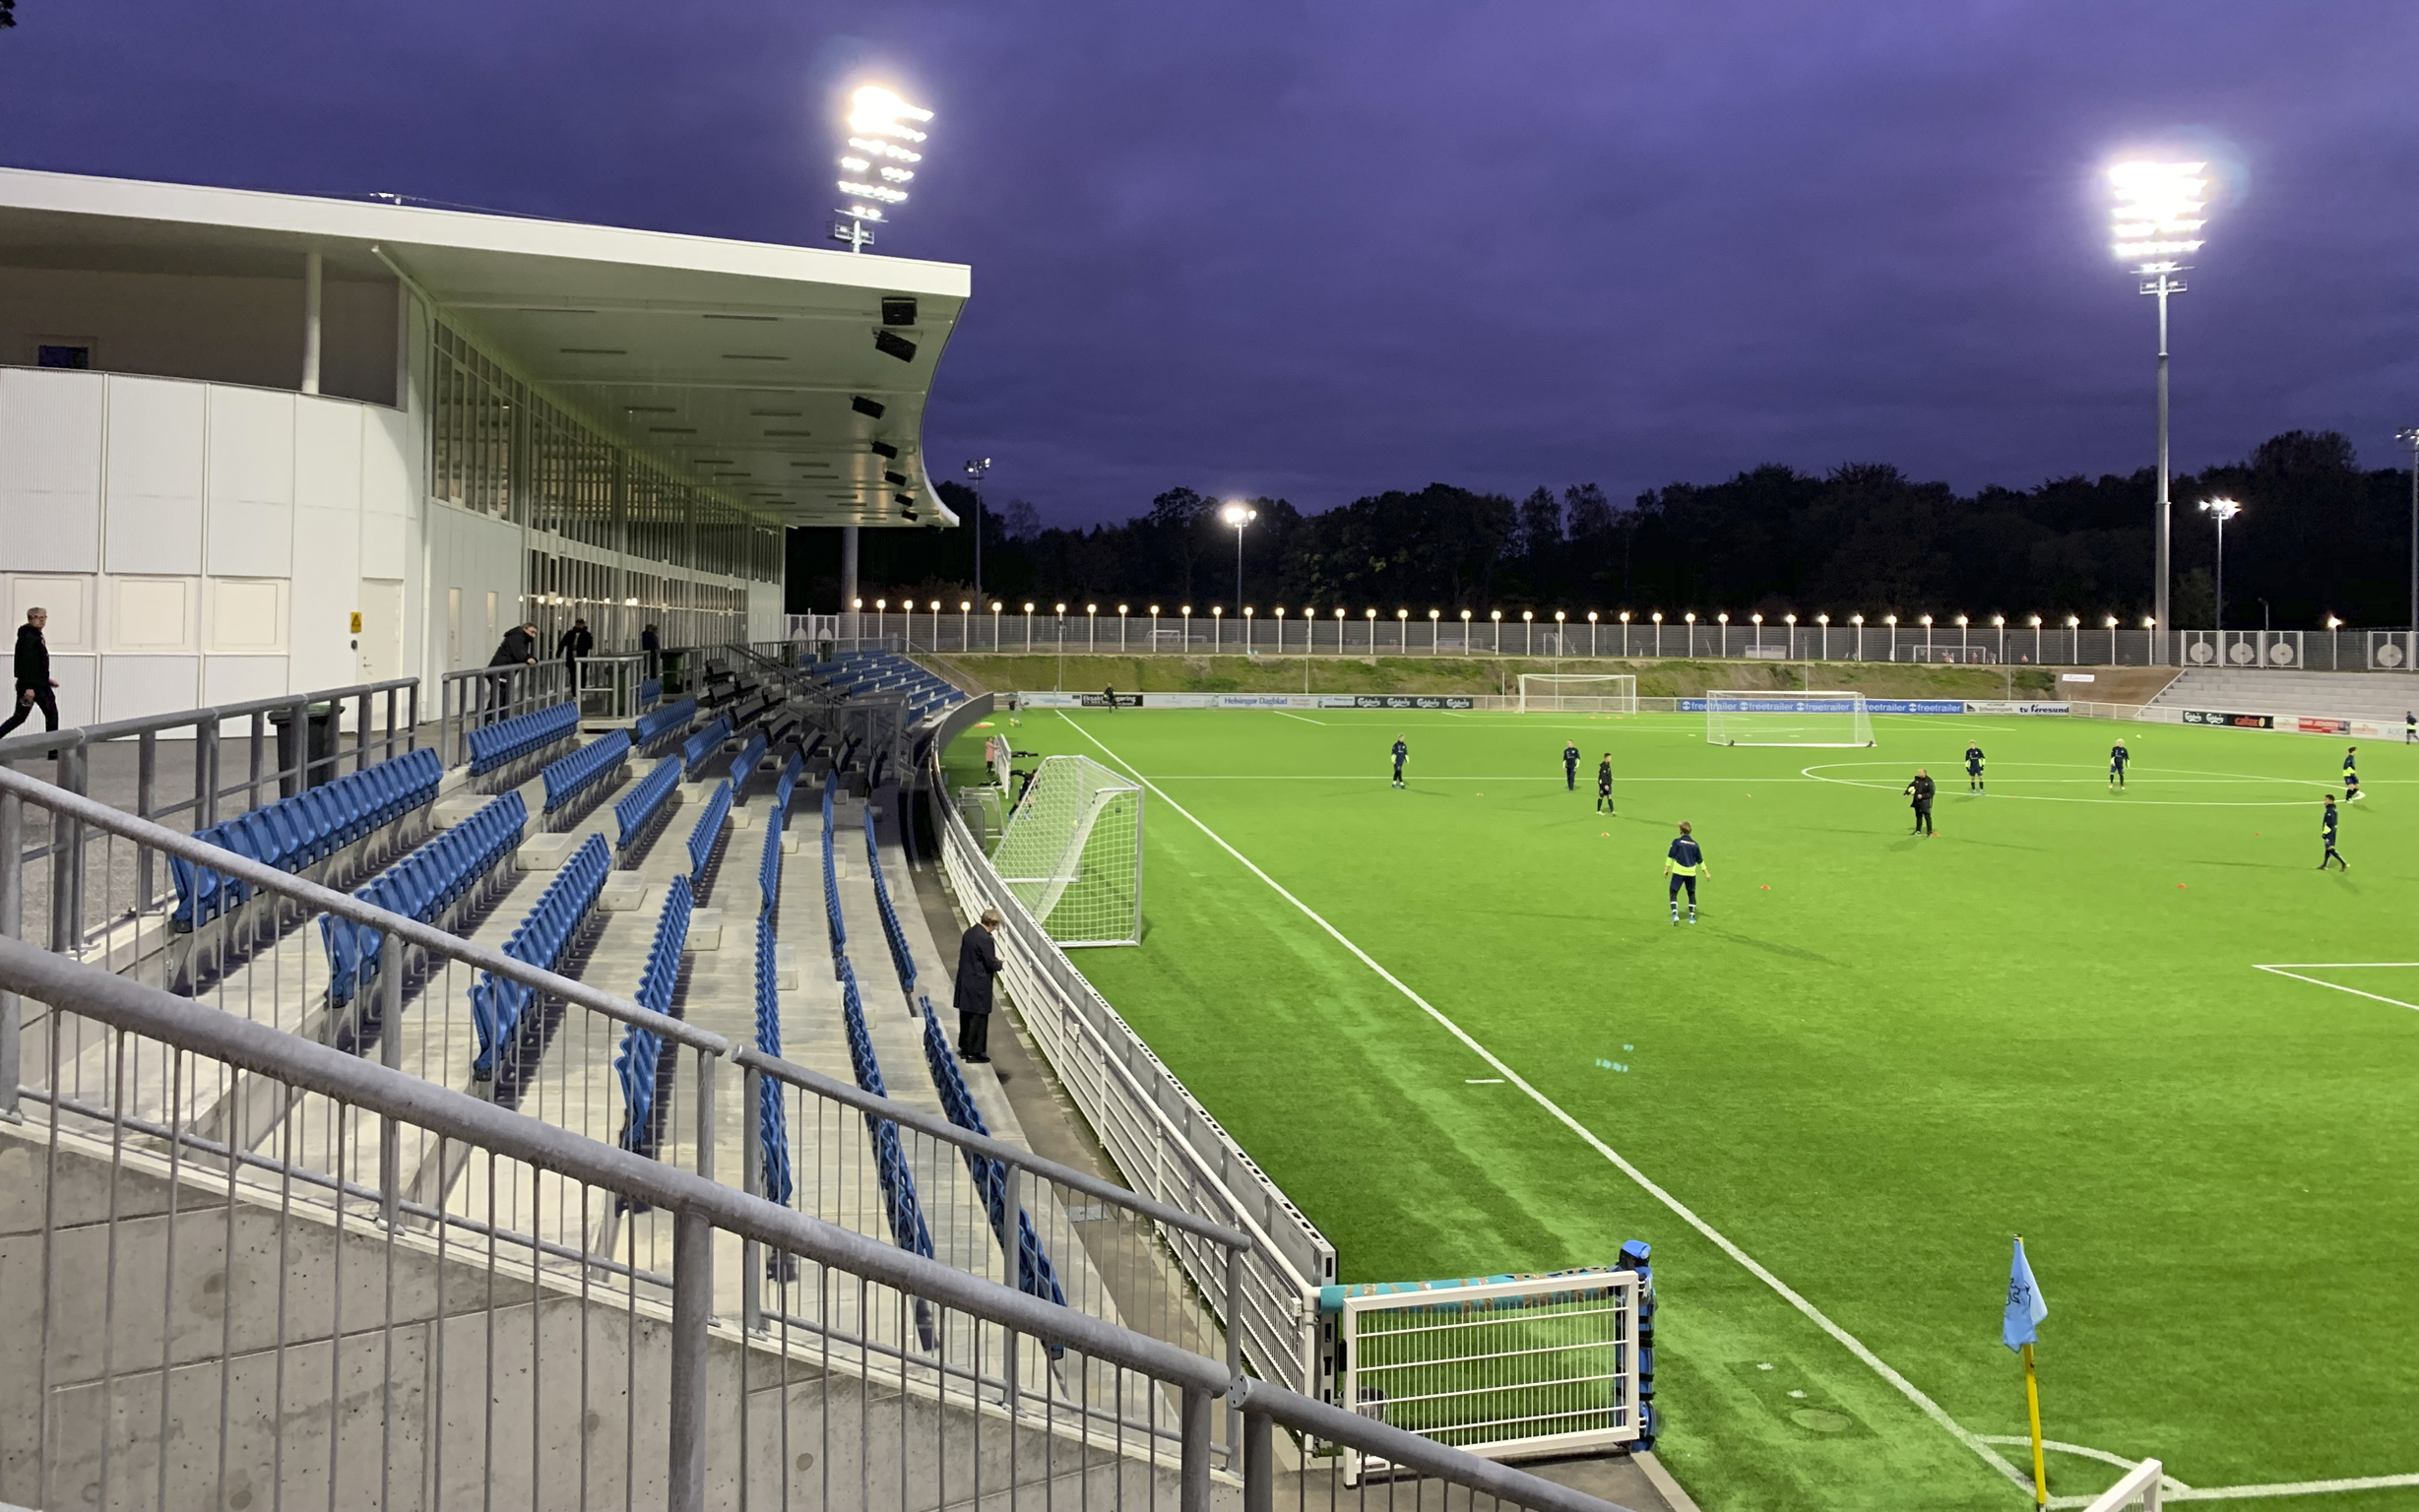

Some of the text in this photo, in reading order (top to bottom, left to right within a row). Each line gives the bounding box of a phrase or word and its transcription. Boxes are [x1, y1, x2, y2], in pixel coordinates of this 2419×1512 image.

[1259, 697, 1288, 707] Dagblad
[1358, 698, 1381, 708] Carlsberg
[1387, 698, 1411, 708] Carlsberg
[1417, 698, 1440, 708] Carlsberg
[1446, 698, 1470, 709] Carlsberg
[1749, 702, 1794, 711] freetrailer
[1806, 703, 1850, 712] freetrailer
[1917, 703, 1960, 713] freetrailer
[2185, 712, 2202, 723] Carlsberg
[2206, 713, 2224, 724] Carlsberg
